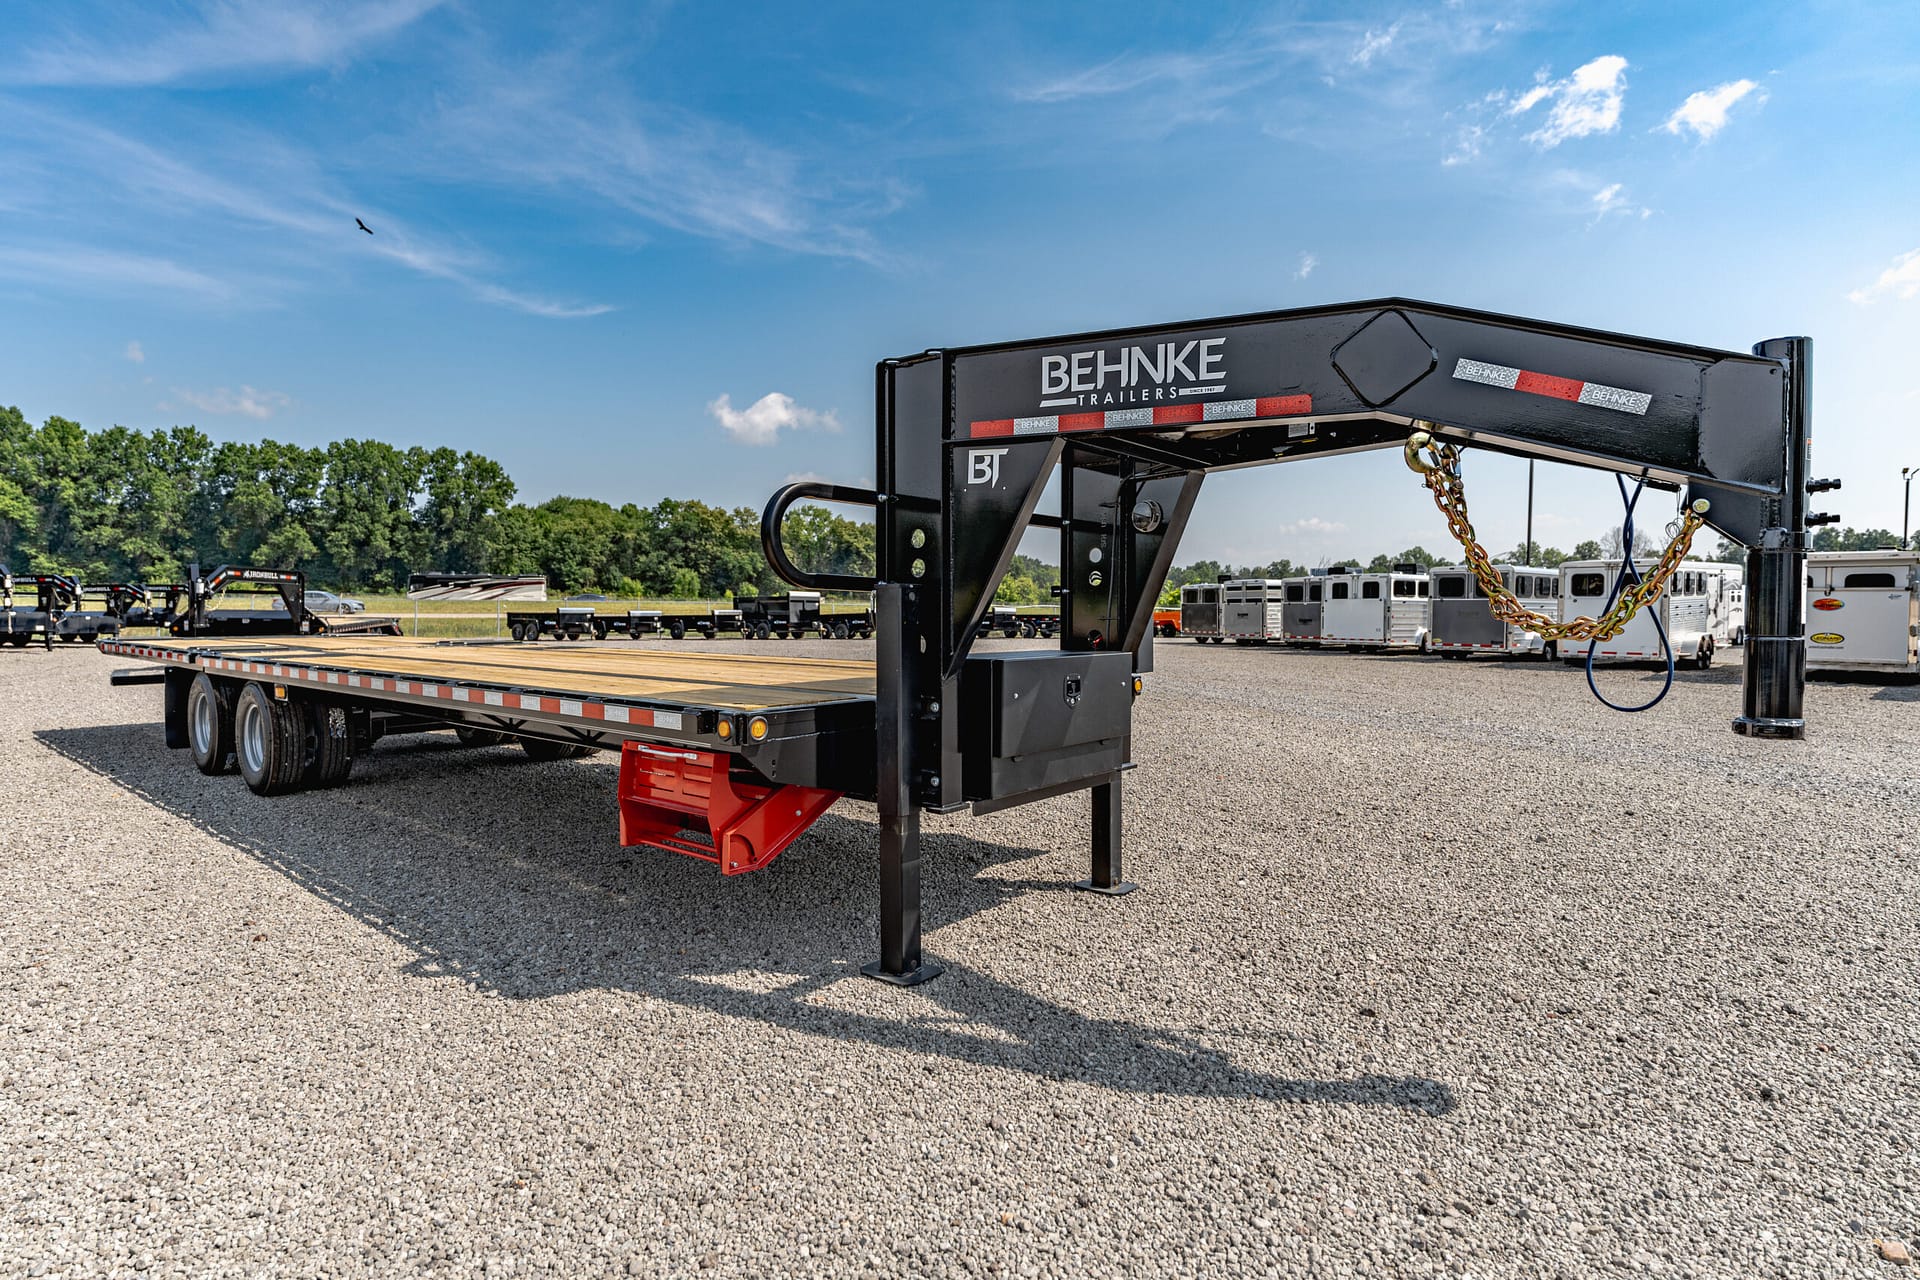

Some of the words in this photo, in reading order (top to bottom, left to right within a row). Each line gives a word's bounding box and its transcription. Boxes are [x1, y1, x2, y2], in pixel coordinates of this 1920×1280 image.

[1041, 337, 1227, 395] BEHNKE
[1466, 365, 1507, 381] BEHNKE
[1078, 386, 1177, 407] TRAILERS
[1592, 390, 1635, 406] BEHNKE
[1021, 419, 1050, 429] BEHNKE
[1113, 412, 1145, 421] BEHNKE
[1212, 403, 1246, 414] BEHNKE
[968, 448, 1009, 489] BT
[250, 570, 278, 579] IRONBULL
